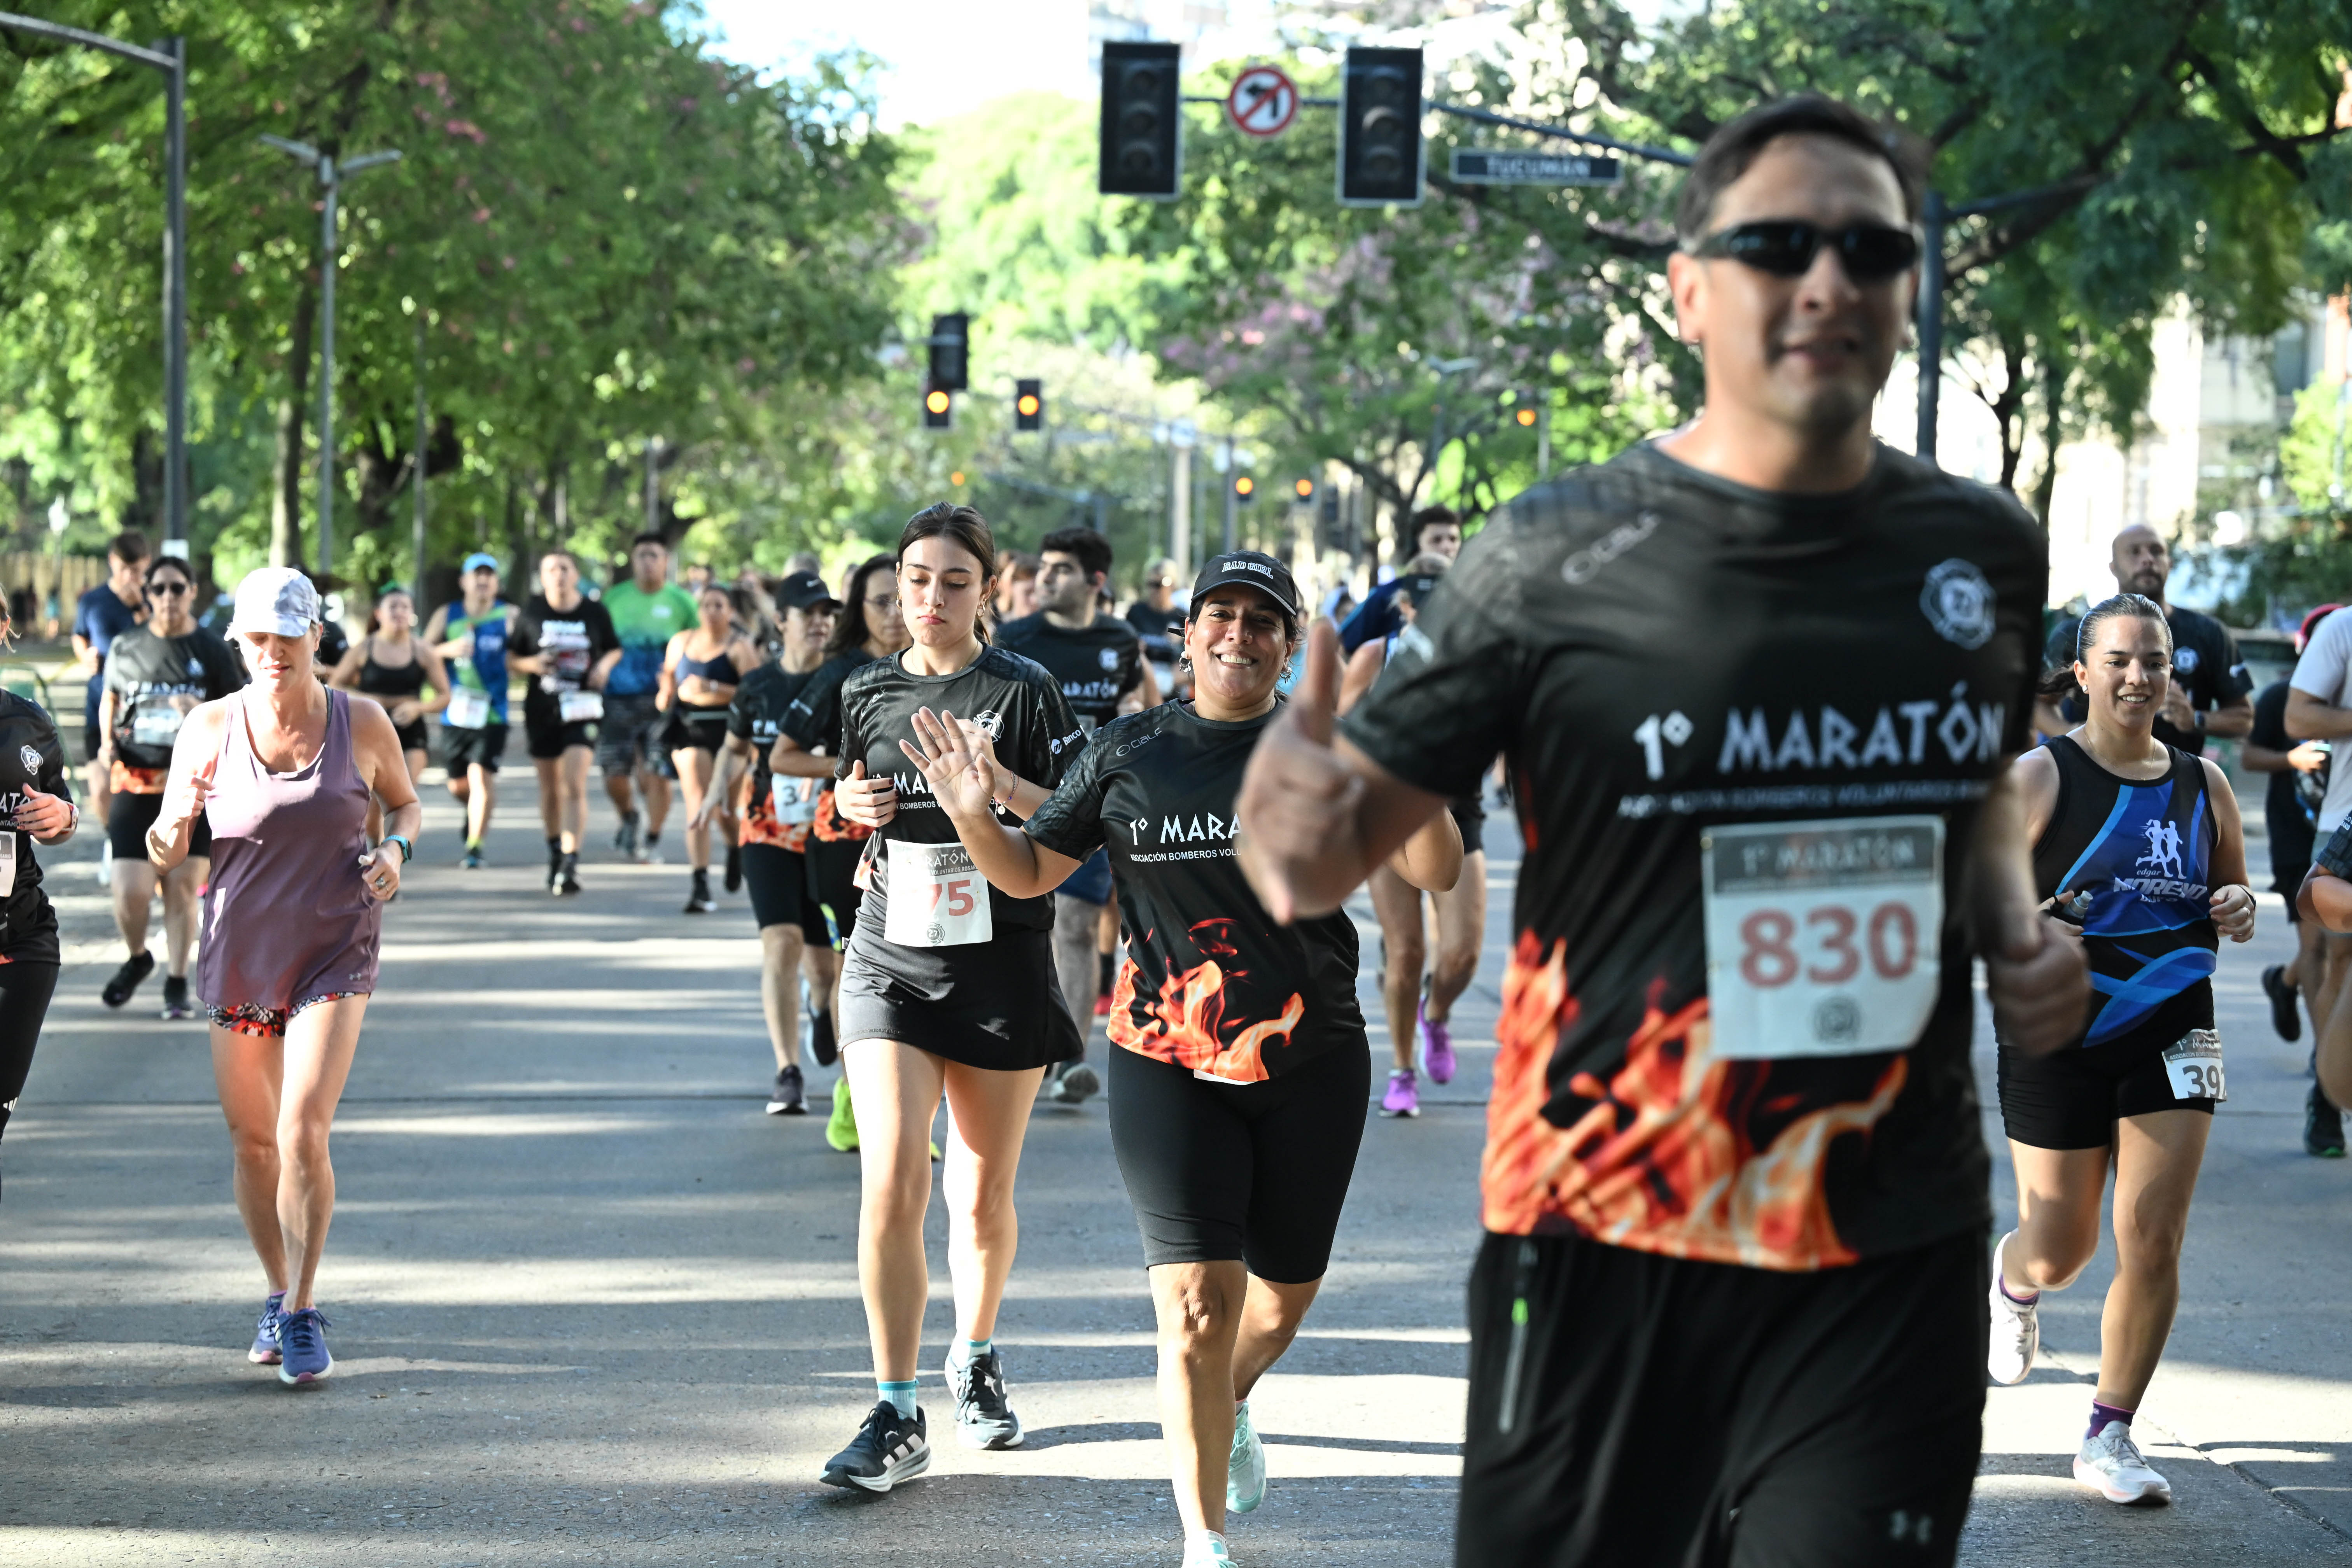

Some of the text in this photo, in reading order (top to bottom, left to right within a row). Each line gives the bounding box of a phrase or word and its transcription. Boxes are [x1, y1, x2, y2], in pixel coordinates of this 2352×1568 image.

[1221, 561, 1273, 579] BAD GIRL
[1716, 679, 2006, 775] MARATÓN
[1062, 730, 1081, 746] Banco
[900, 801, 936, 810] BOMBEROS
[1160, 811, 1242, 844] MARA
[1168, 849, 1217, 861] BOMBEROS
[2137, 868, 2161, 877] edgar
[928, 929, 938, 938] 27
[1738, 900, 1919, 990] 830
